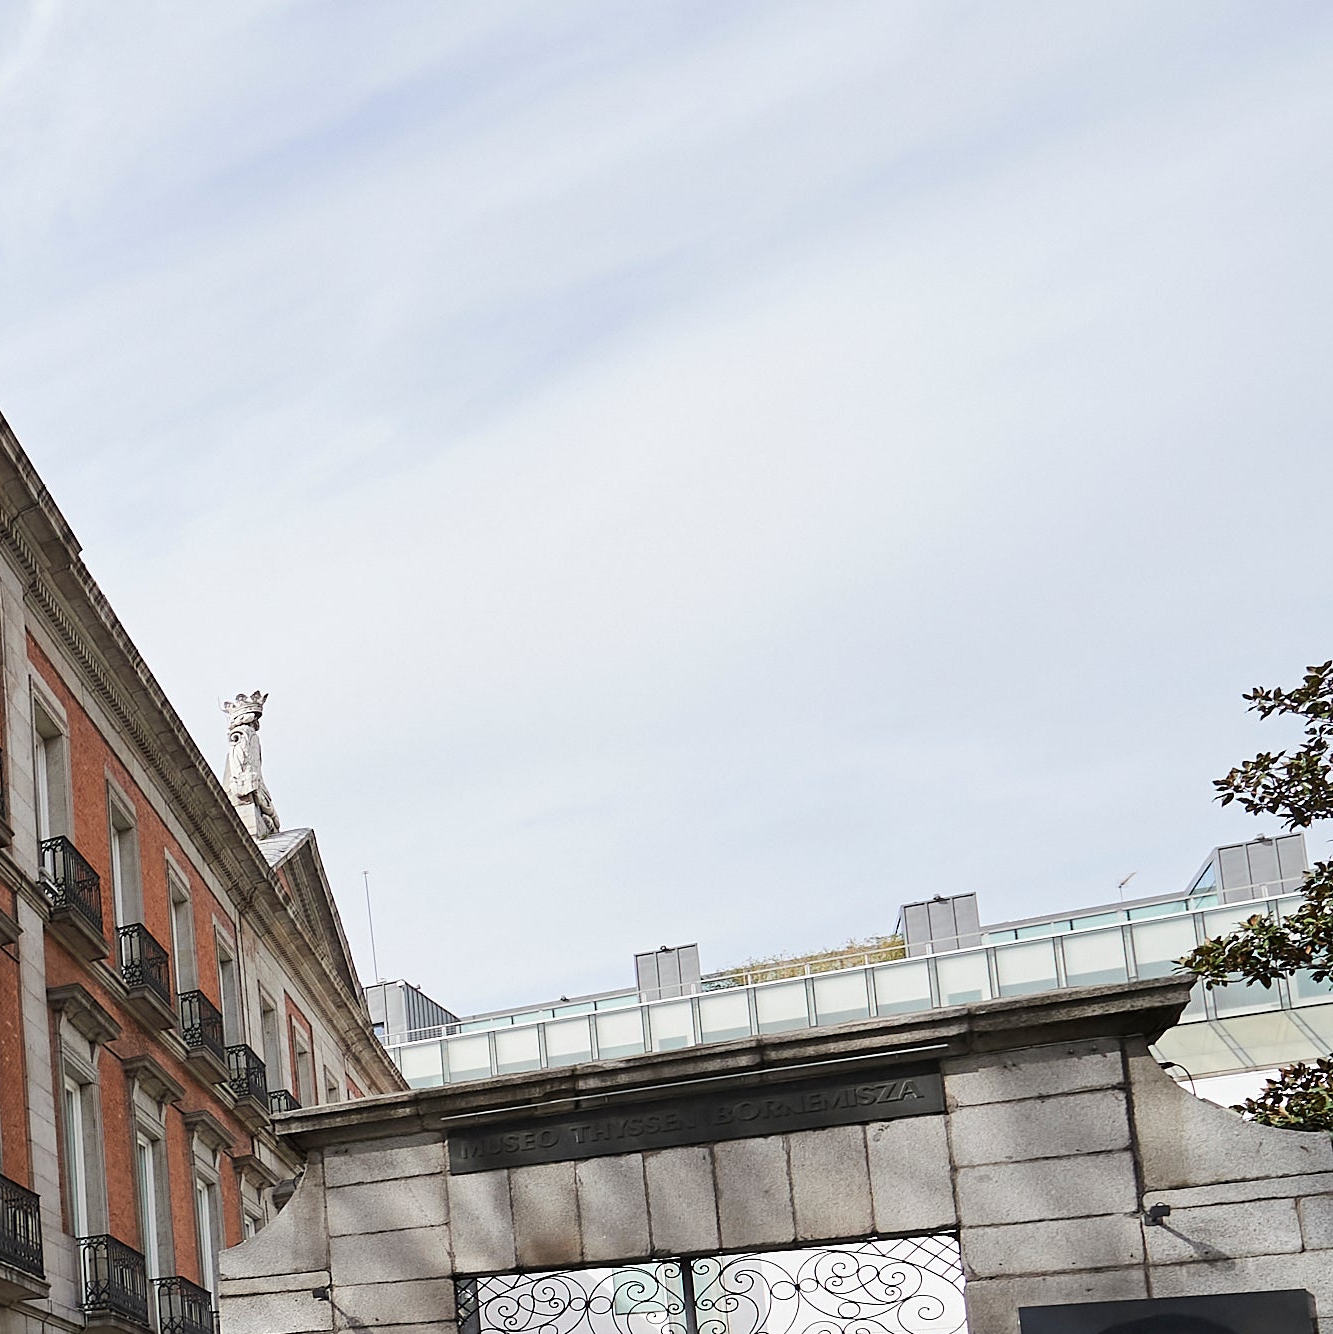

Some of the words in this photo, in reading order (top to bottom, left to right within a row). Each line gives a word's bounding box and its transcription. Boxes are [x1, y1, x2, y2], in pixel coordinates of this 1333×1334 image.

[460, 1129, 560, 1160] MUSEO
[571, 1109, 698, 1145] THYSSEN
[714, 1079, 925, 1126] BORNEMISZA
